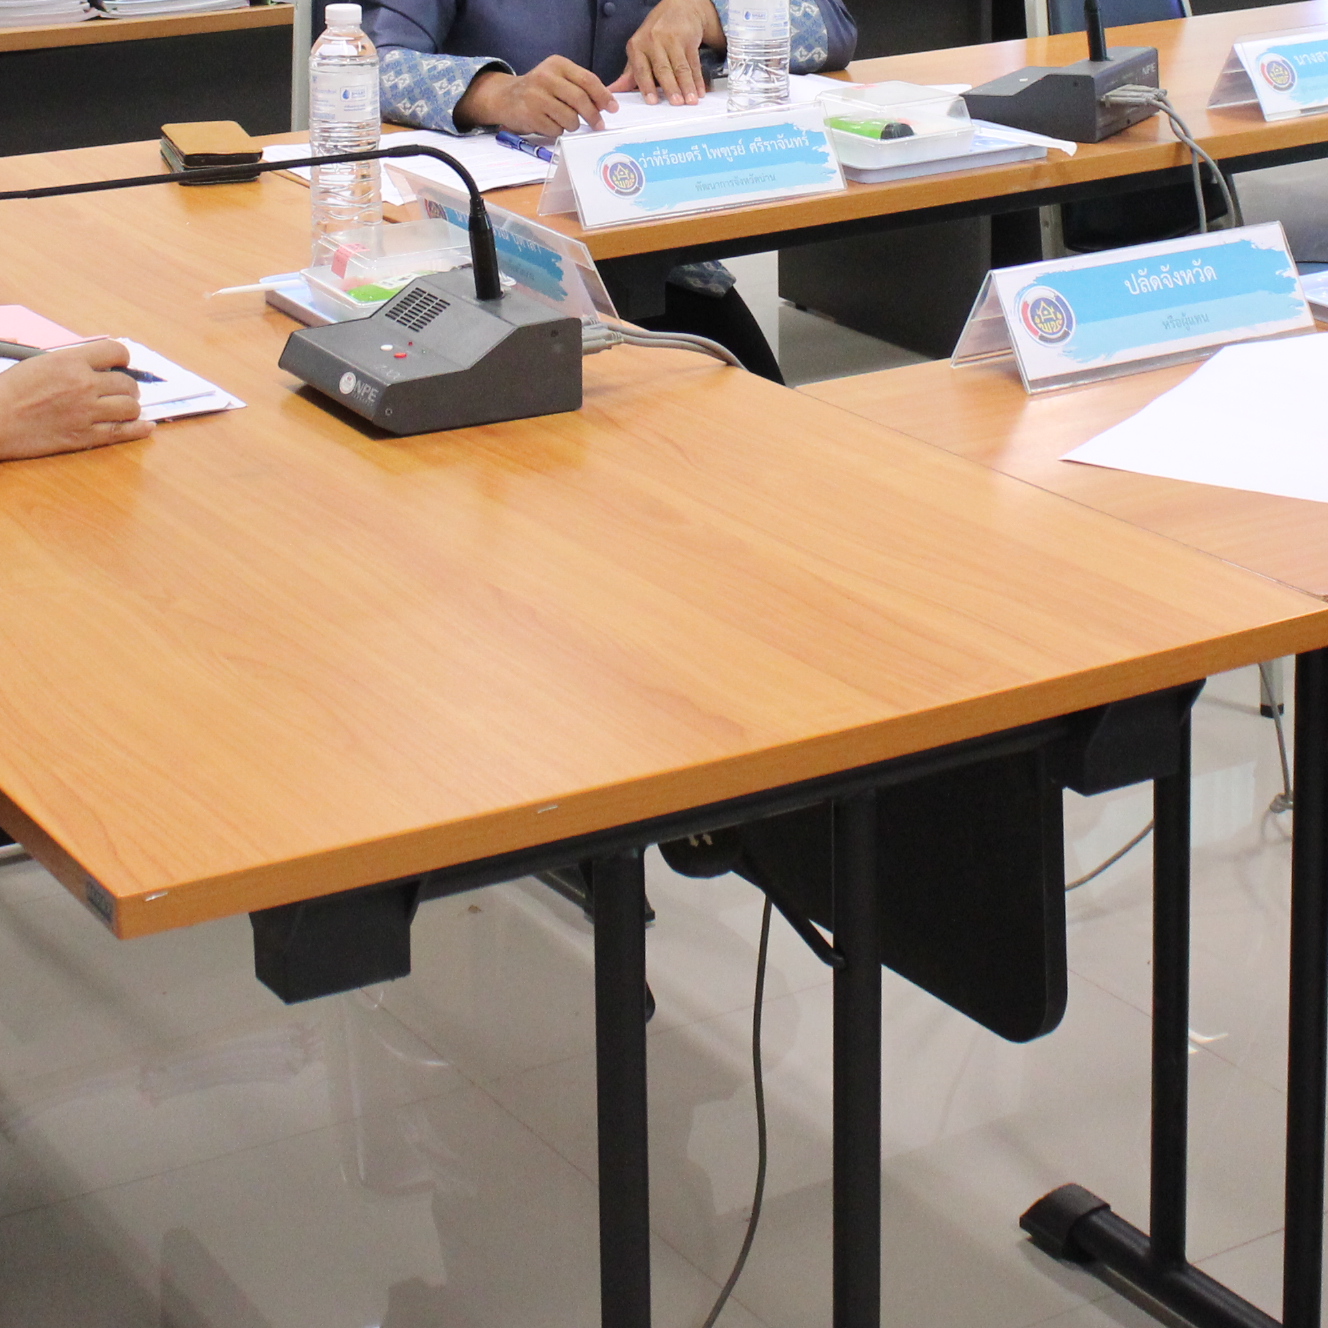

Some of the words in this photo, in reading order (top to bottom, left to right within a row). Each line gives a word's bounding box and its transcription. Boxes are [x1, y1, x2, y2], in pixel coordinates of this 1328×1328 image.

[638, 144, 702, 169] ว่าที่ร้อยตรี
[702, 138, 747, 162] ไพฑูรย์
[1124, 258, 1218, 295] ปลัดจังหวัด
[1161, 312, 1211, 331] หรือผู้แทน
[353, 379, 379, 403] NPE
